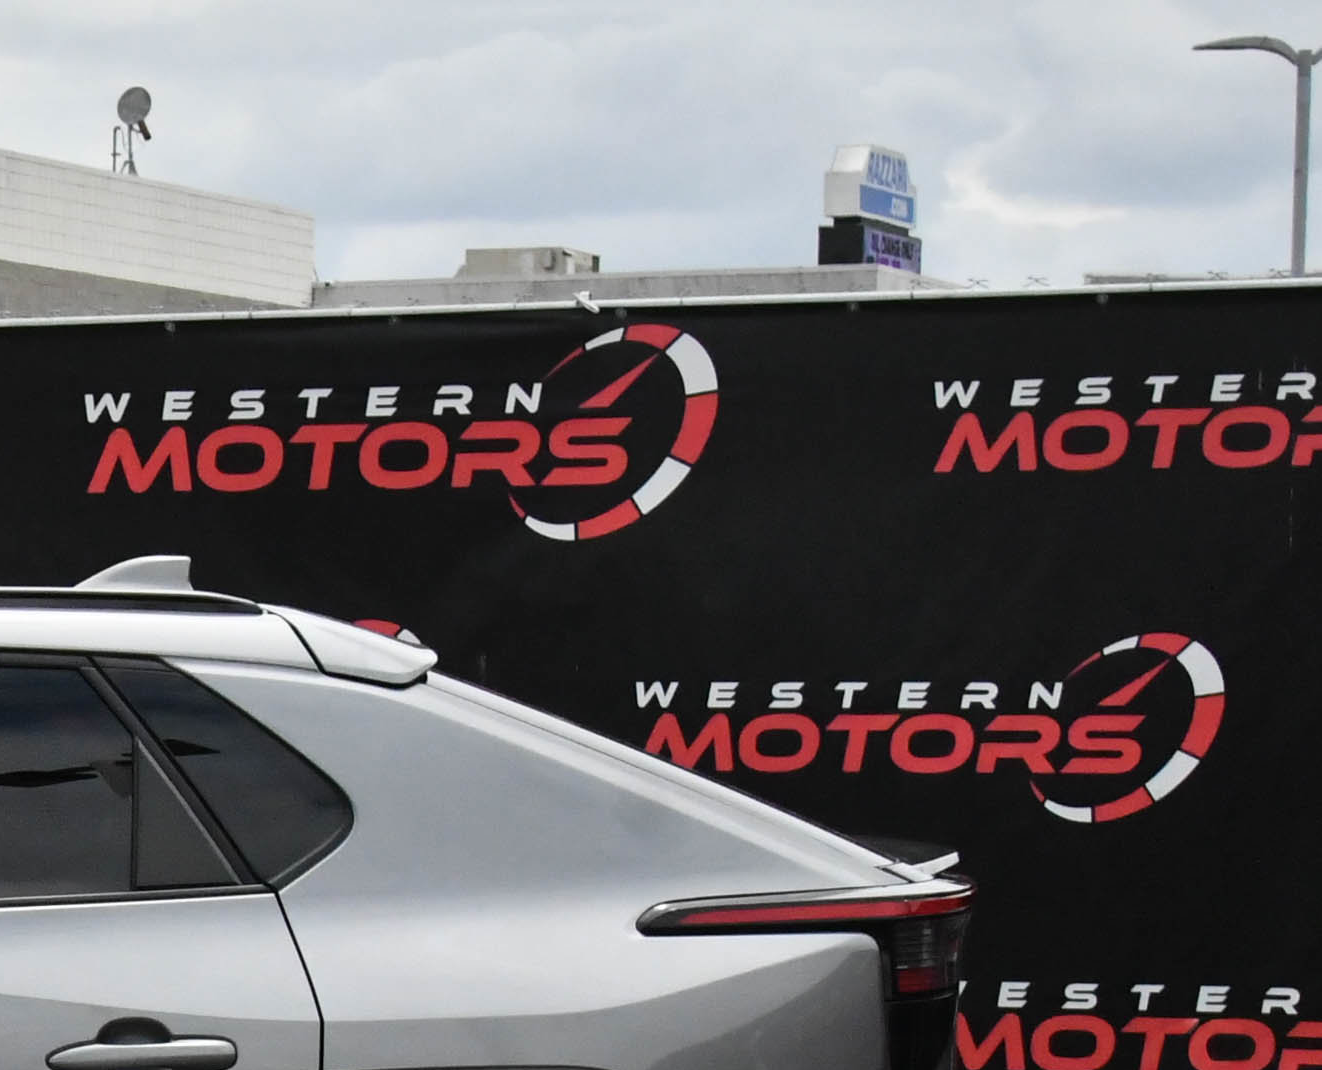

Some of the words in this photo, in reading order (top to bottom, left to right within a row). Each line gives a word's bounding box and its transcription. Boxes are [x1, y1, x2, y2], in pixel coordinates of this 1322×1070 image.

[85, 383, 542, 423] WESTERN
[935, 373, 1316, 408] WESTER
[88, 417, 631, 493] MOTORS
[935, 406, 1322, 472] MOTO
[636, 682, 1062, 709] WESTERN
[646, 714, 1144, 773] MOTORS
[959, 981, 1300, 1014] ESTER
